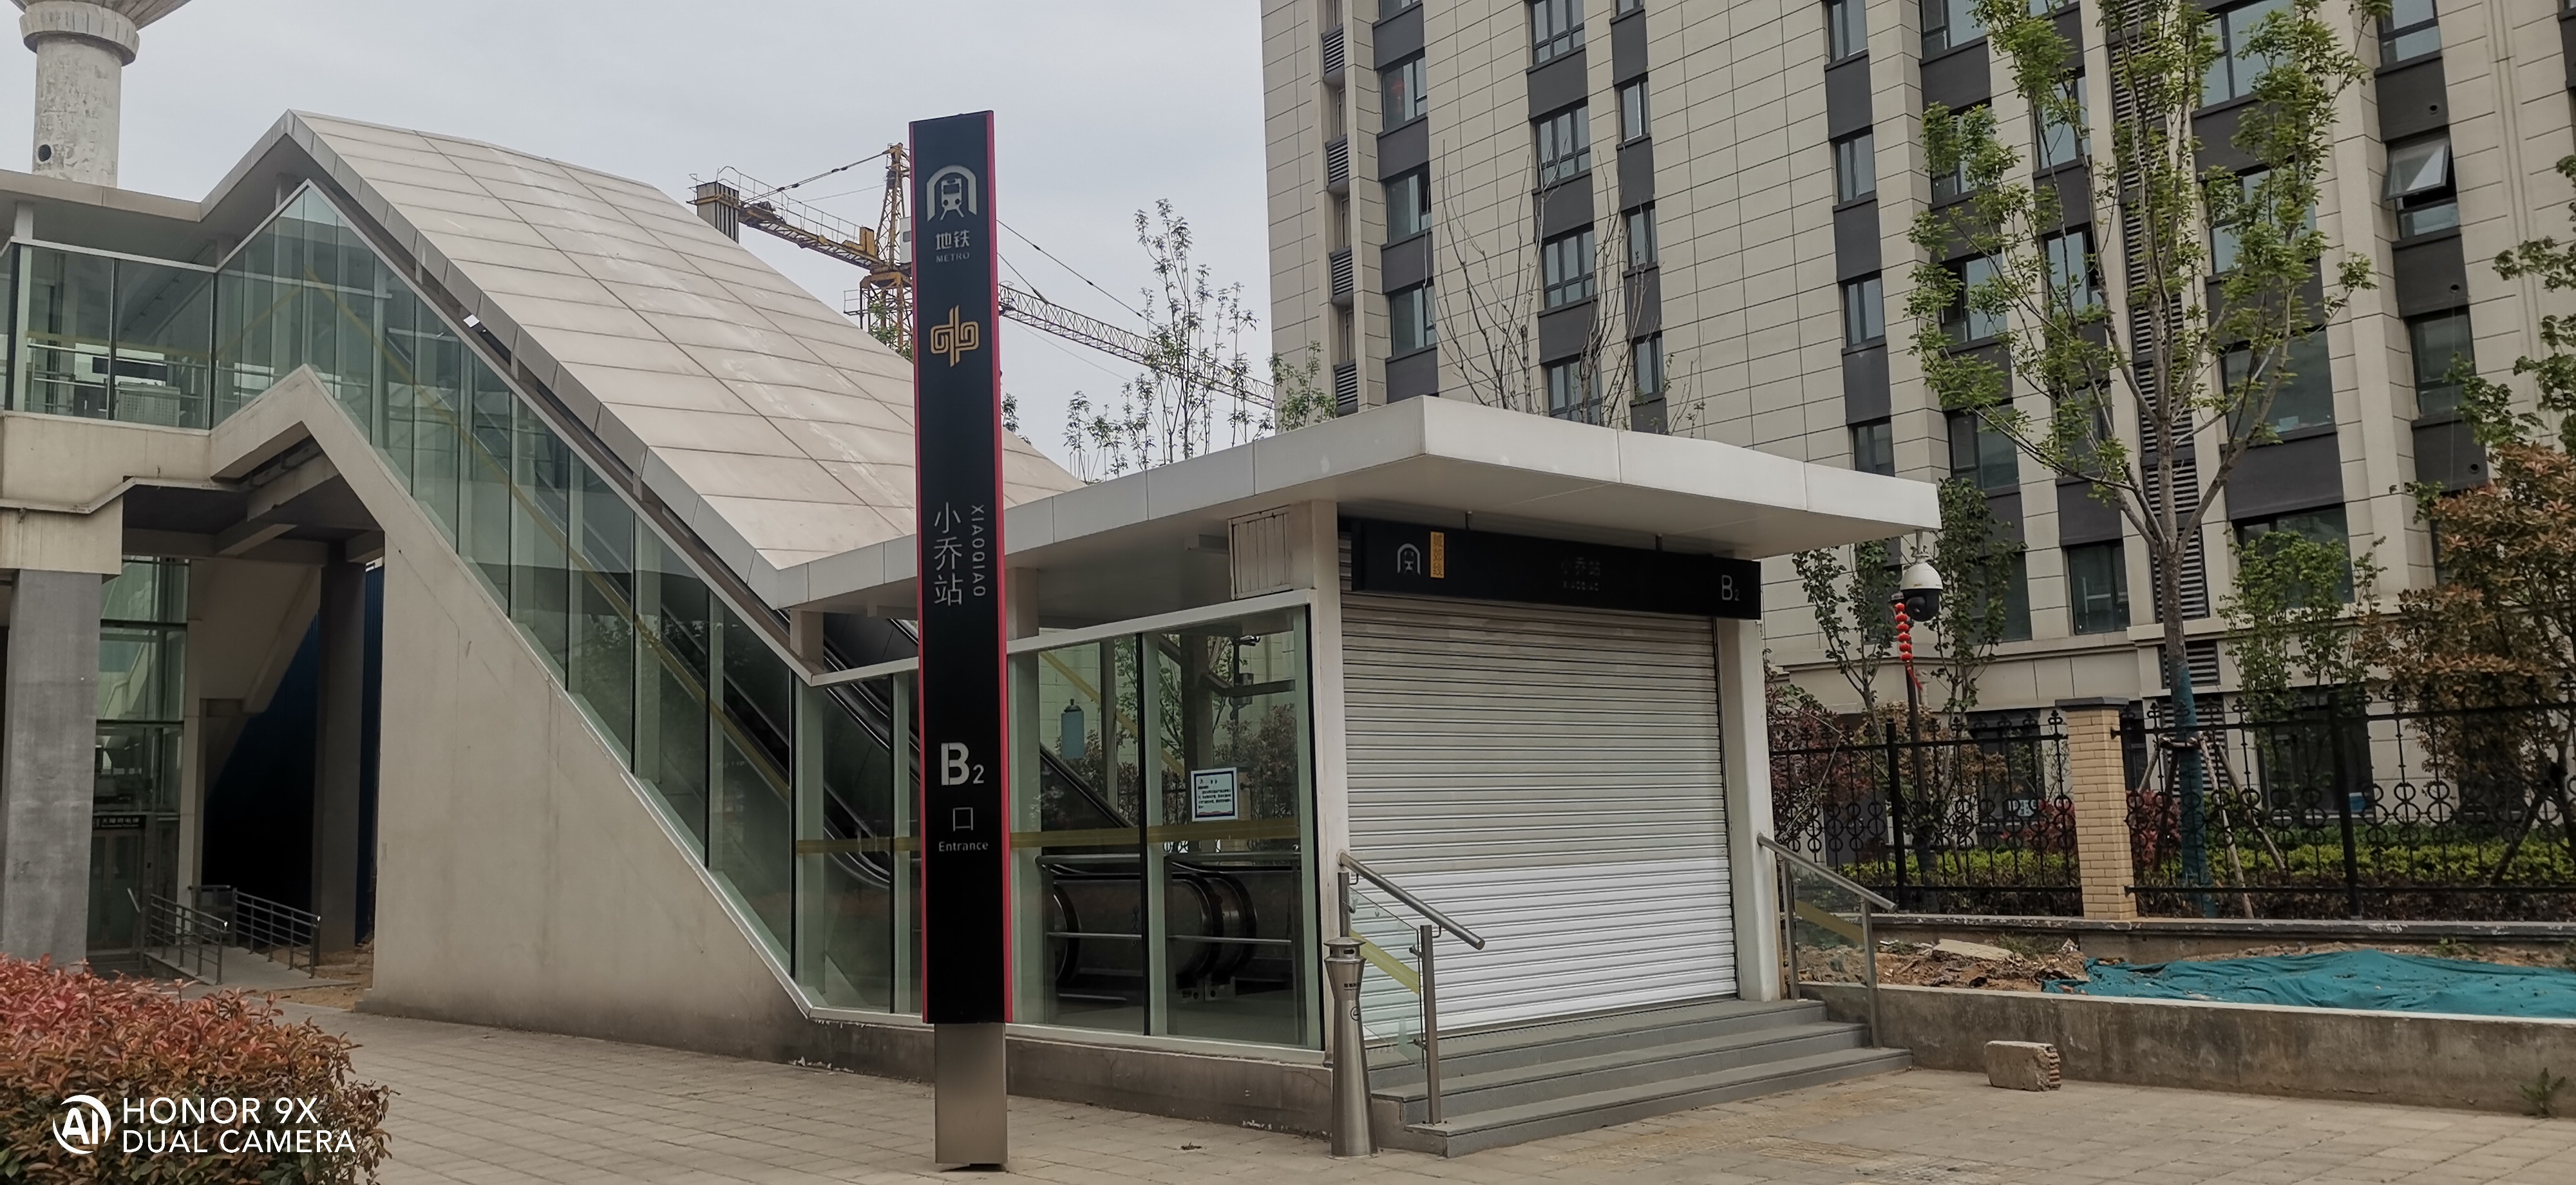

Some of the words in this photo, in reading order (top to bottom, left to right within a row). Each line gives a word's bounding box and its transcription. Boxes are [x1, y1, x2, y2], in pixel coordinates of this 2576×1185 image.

[934, 229, 971, 250] 地铁
[935, 252, 971, 263] METRO
[933, 502, 963, 607] 小乔站
[971, 504, 987, 597] XIAOQIAO
[1721, 574, 1741, 602] B2
[940, 742, 985, 786] B2
[952, 806, 974, 833] 口
[938, 840, 989, 852] Entrance
